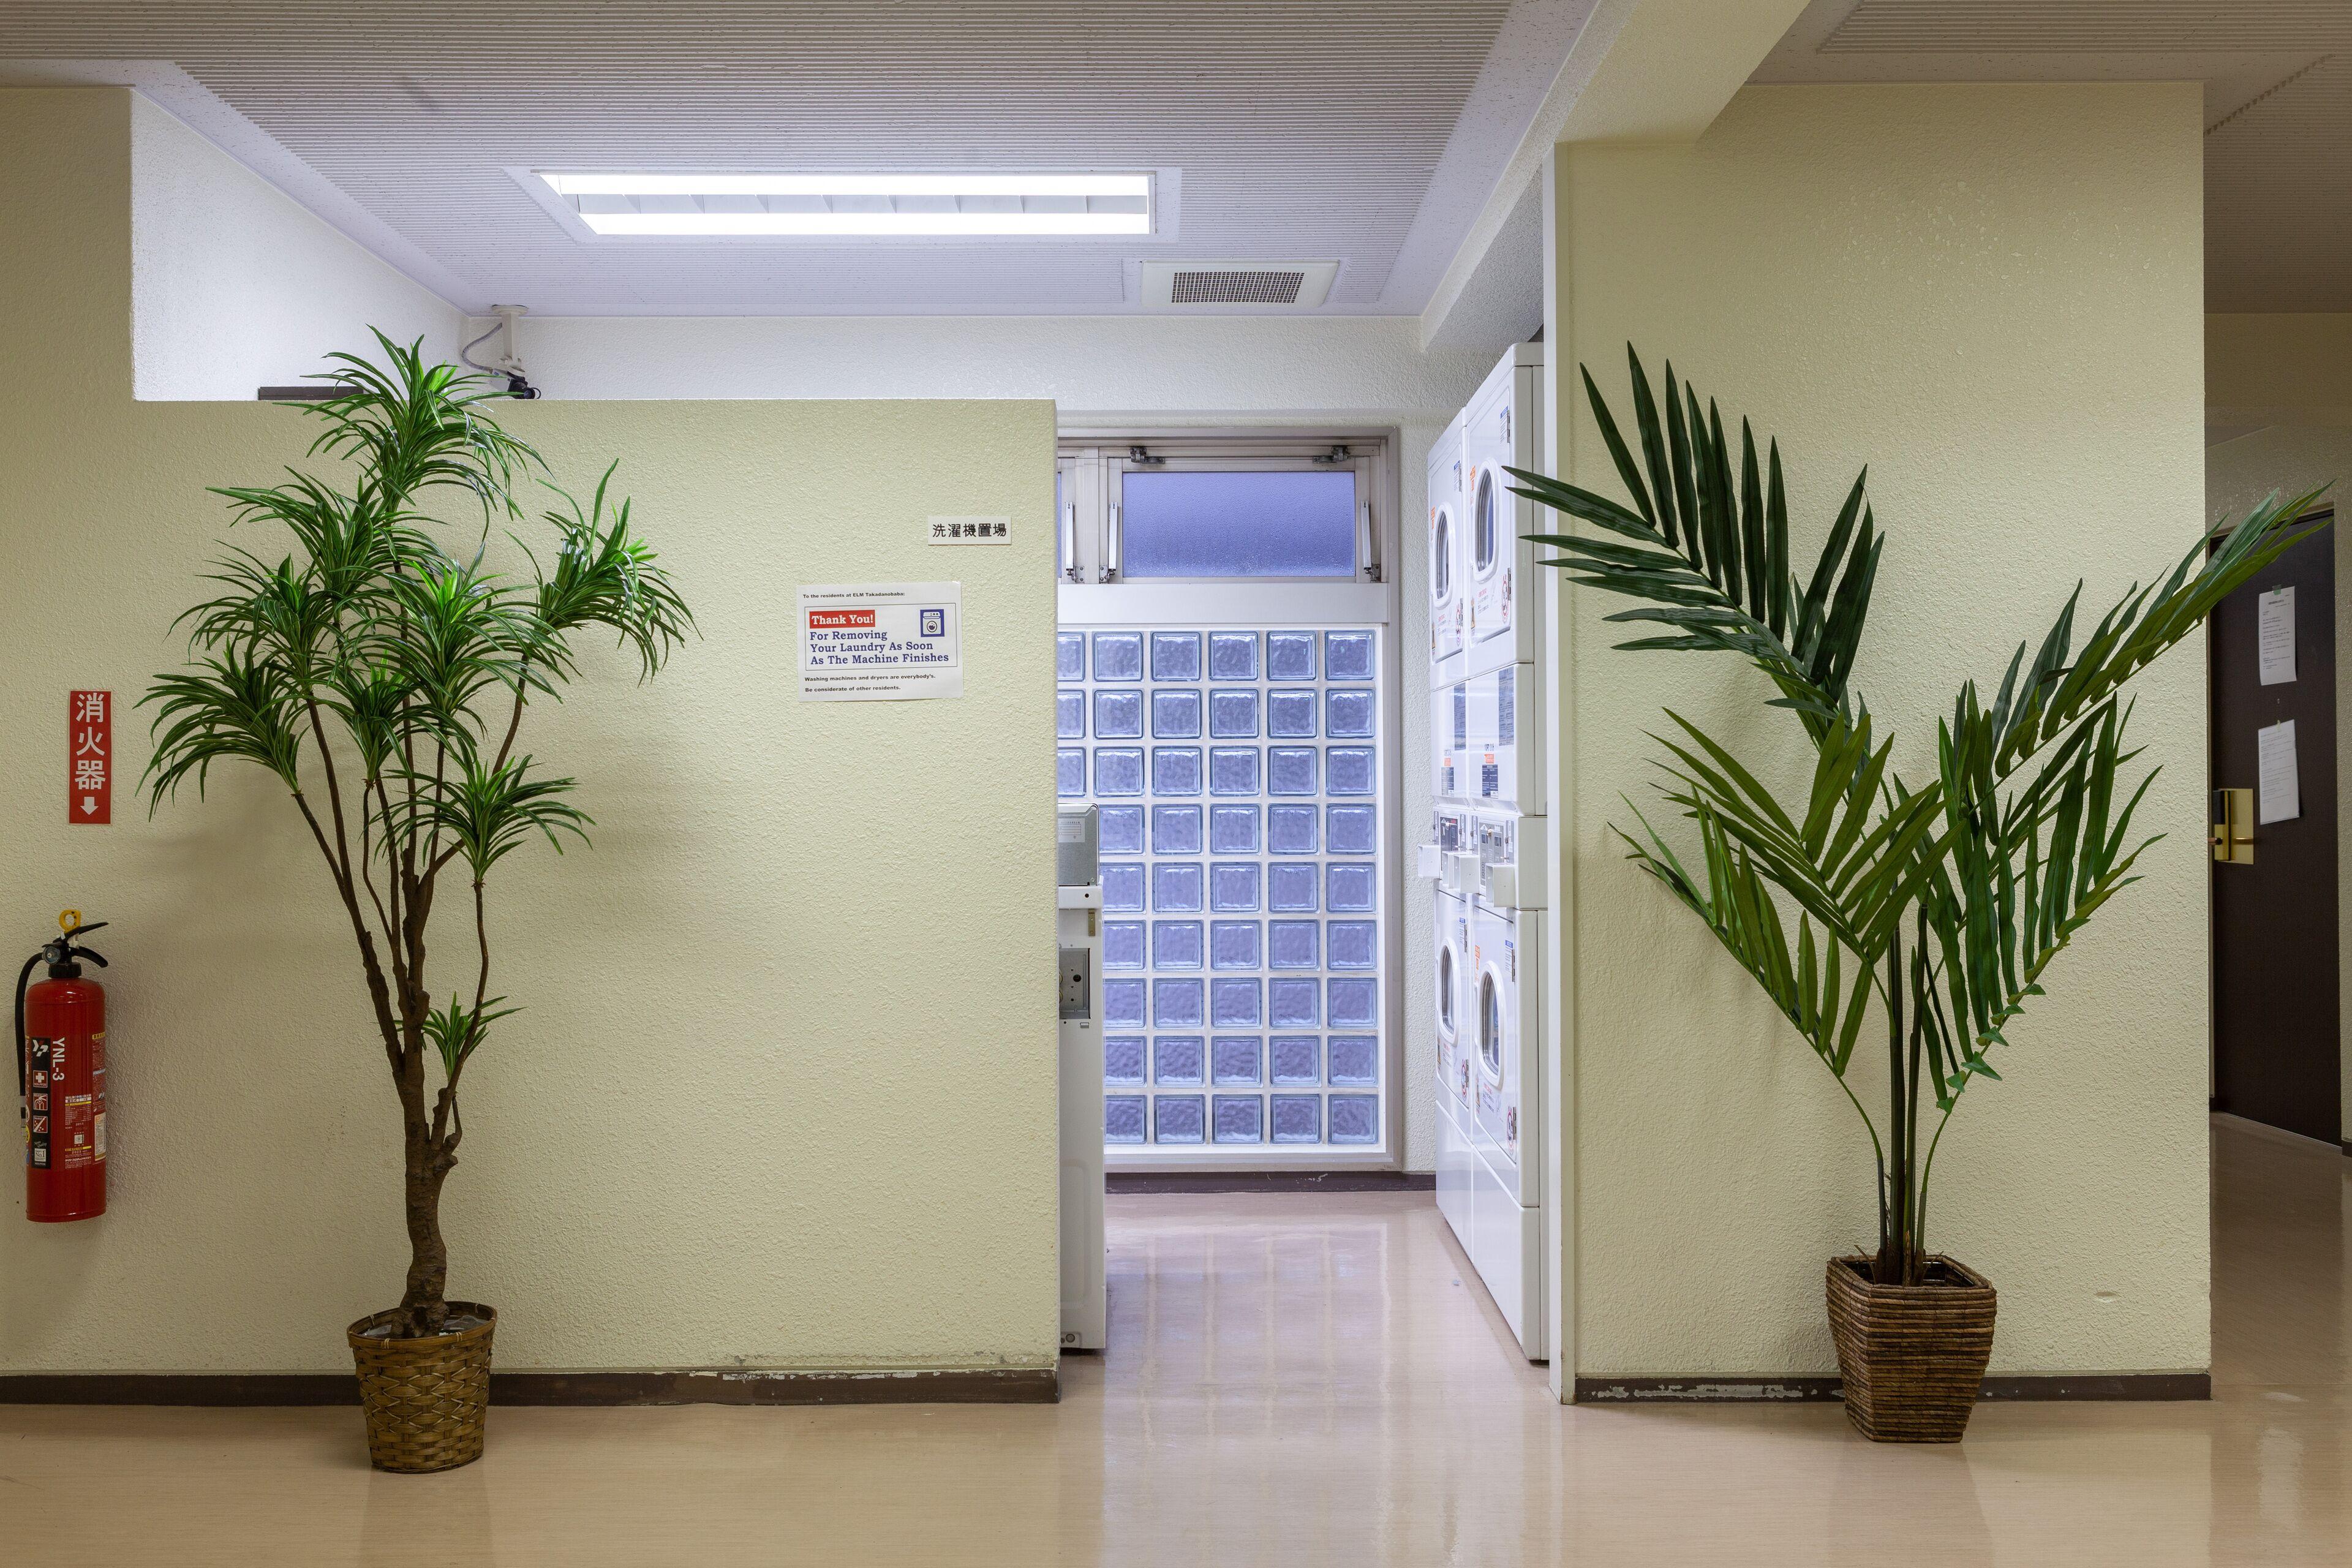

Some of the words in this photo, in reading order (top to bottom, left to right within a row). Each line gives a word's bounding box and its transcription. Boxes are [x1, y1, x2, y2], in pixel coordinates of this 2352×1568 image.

[932, 523, 1006, 537] 洗濯機置場
[812, 614, 846, 625] Thank
[849, 614, 874, 624] You!
[810, 631, 829, 640] For
[832, 630, 888, 641] Removing
[810, 643, 837, 652] Your
[840, 643, 886, 653] Laundry
[889, 642, 902, 650] As
[810, 656, 824, 665] As
[827, 655, 848, 664] The
[852, 655, 899, 664] Machine
[902, 654, 949, 662] Finishes
[75, 692, 106, 790] 消火器
[52, 1037, 65, 1081] YNL-3
